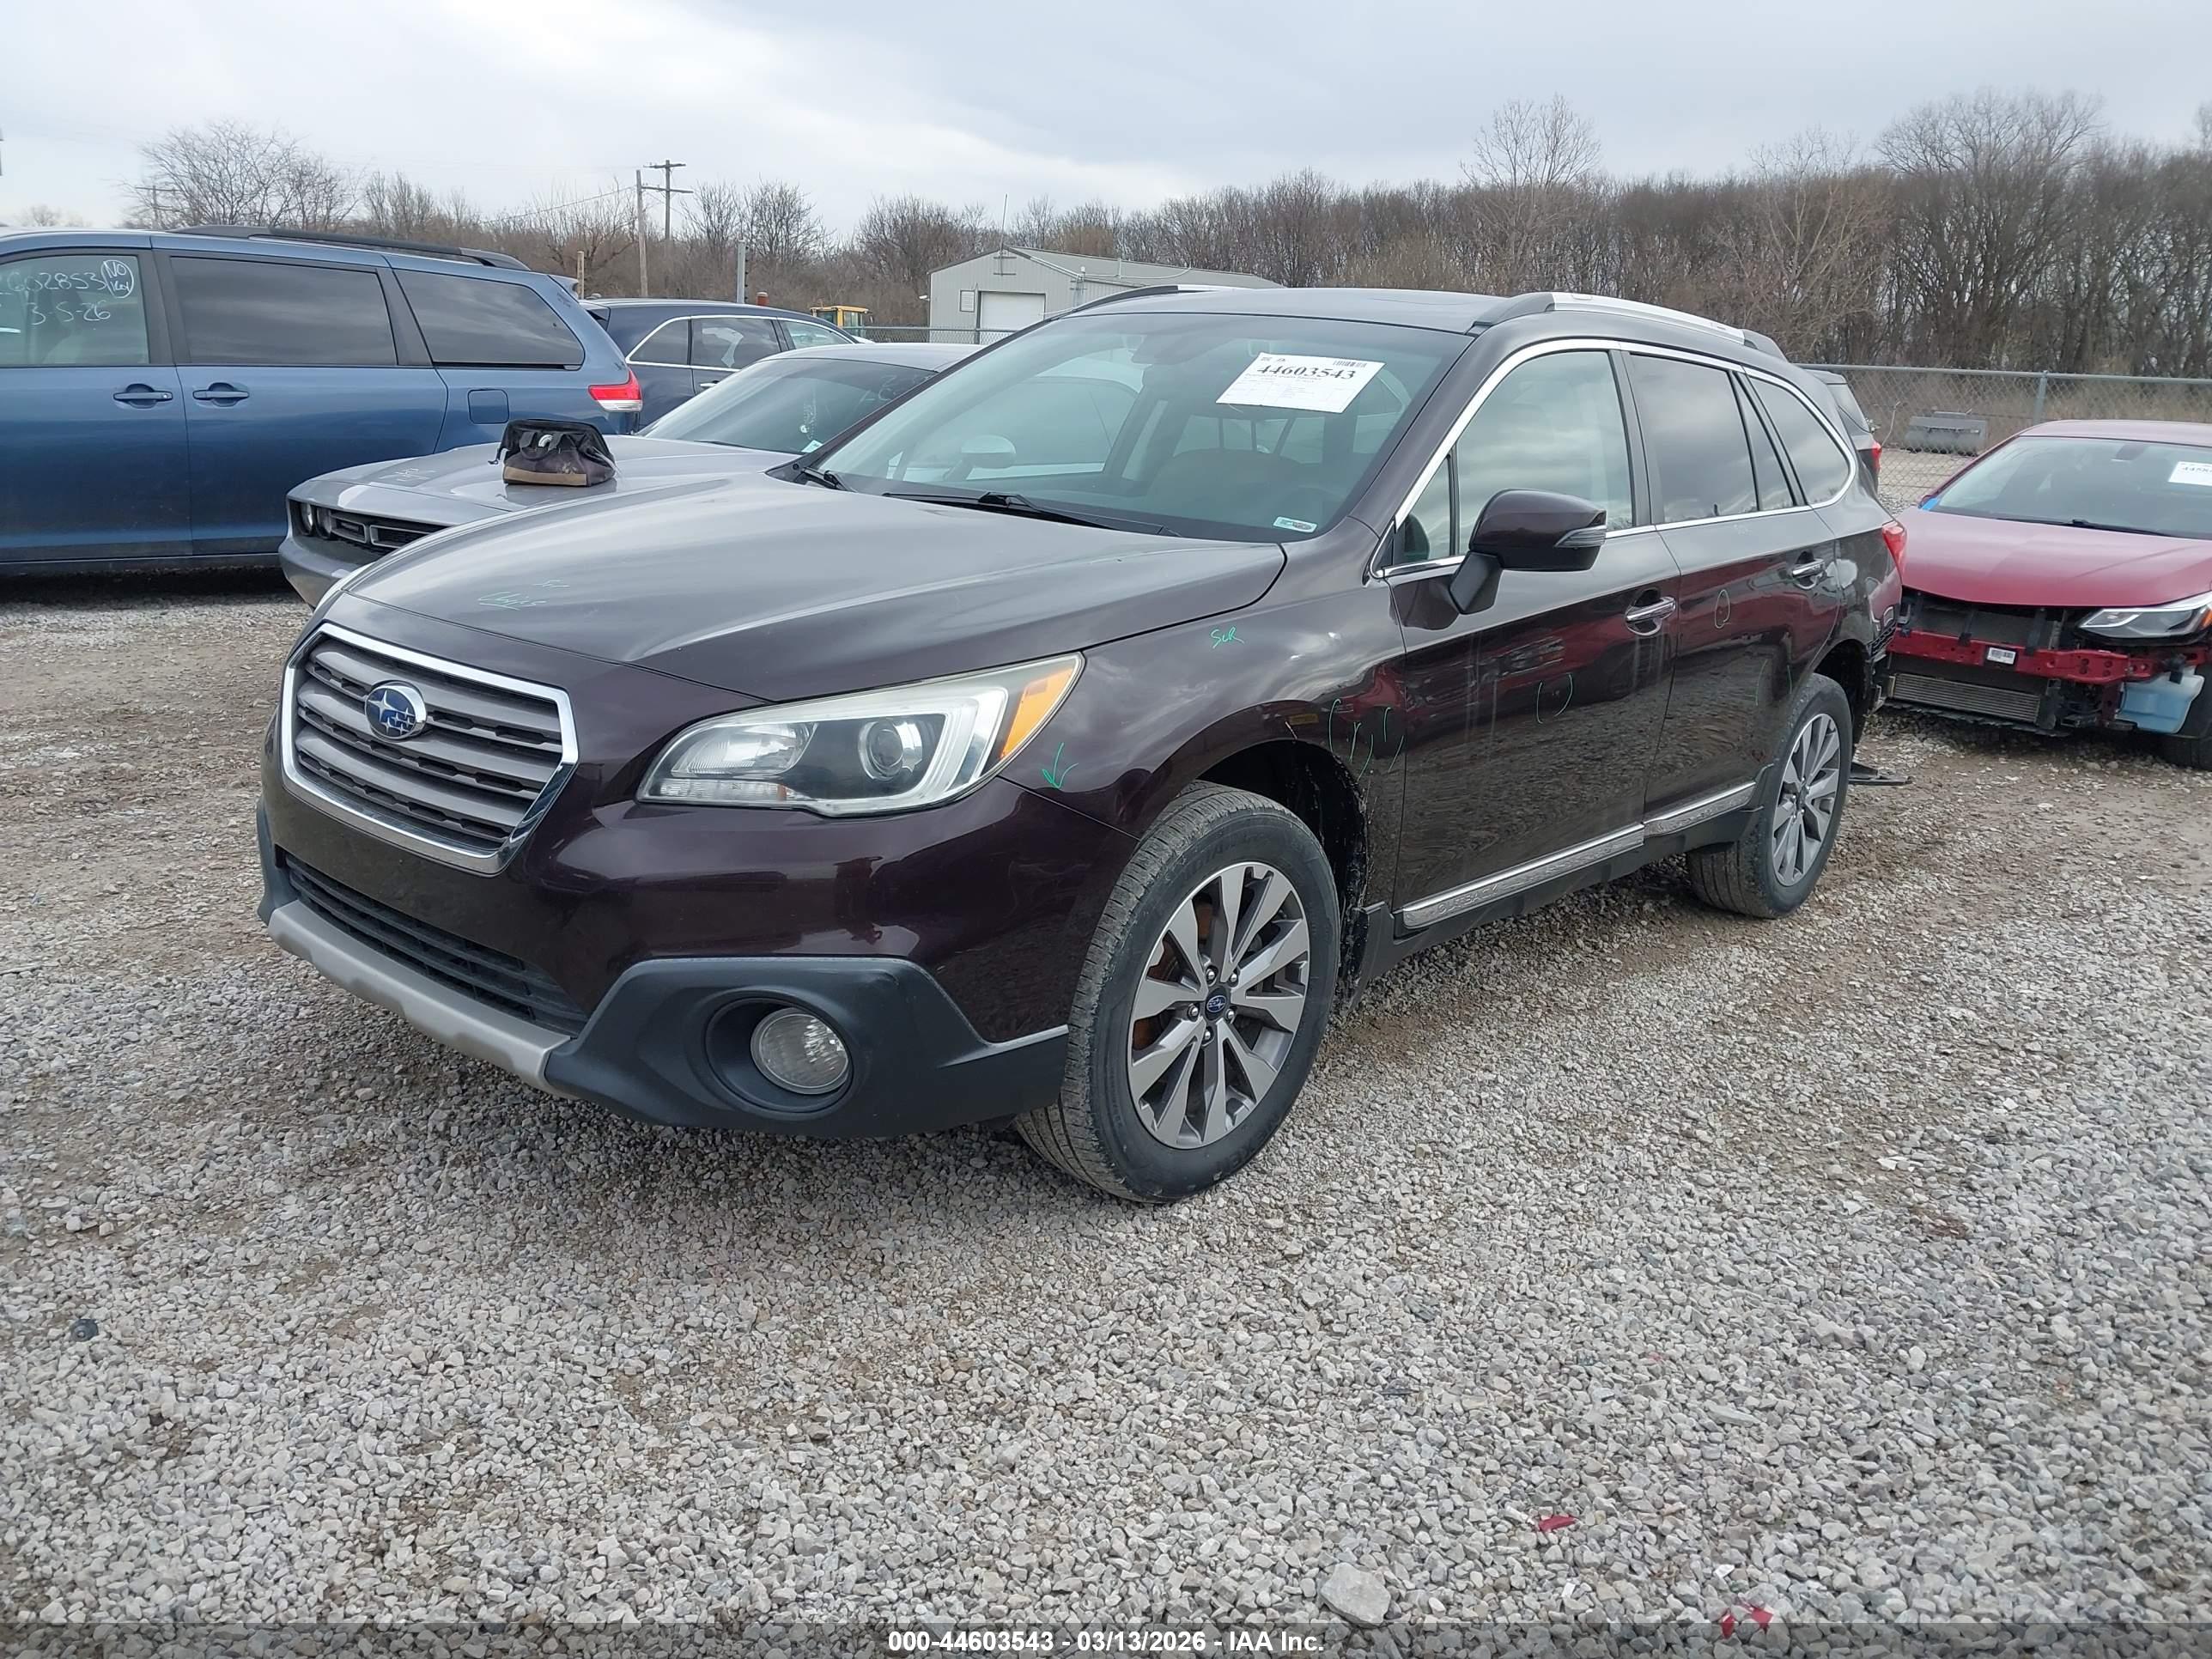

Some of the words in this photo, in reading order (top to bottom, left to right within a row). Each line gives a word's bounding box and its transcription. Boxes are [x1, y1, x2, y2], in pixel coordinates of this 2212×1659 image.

[103, 261, 127, 278] NO
[0, 271, 108, 292] 602853
[26, 300, 111, 325] 3-5-26
[1257, 364, 1356, 380] 44603543
